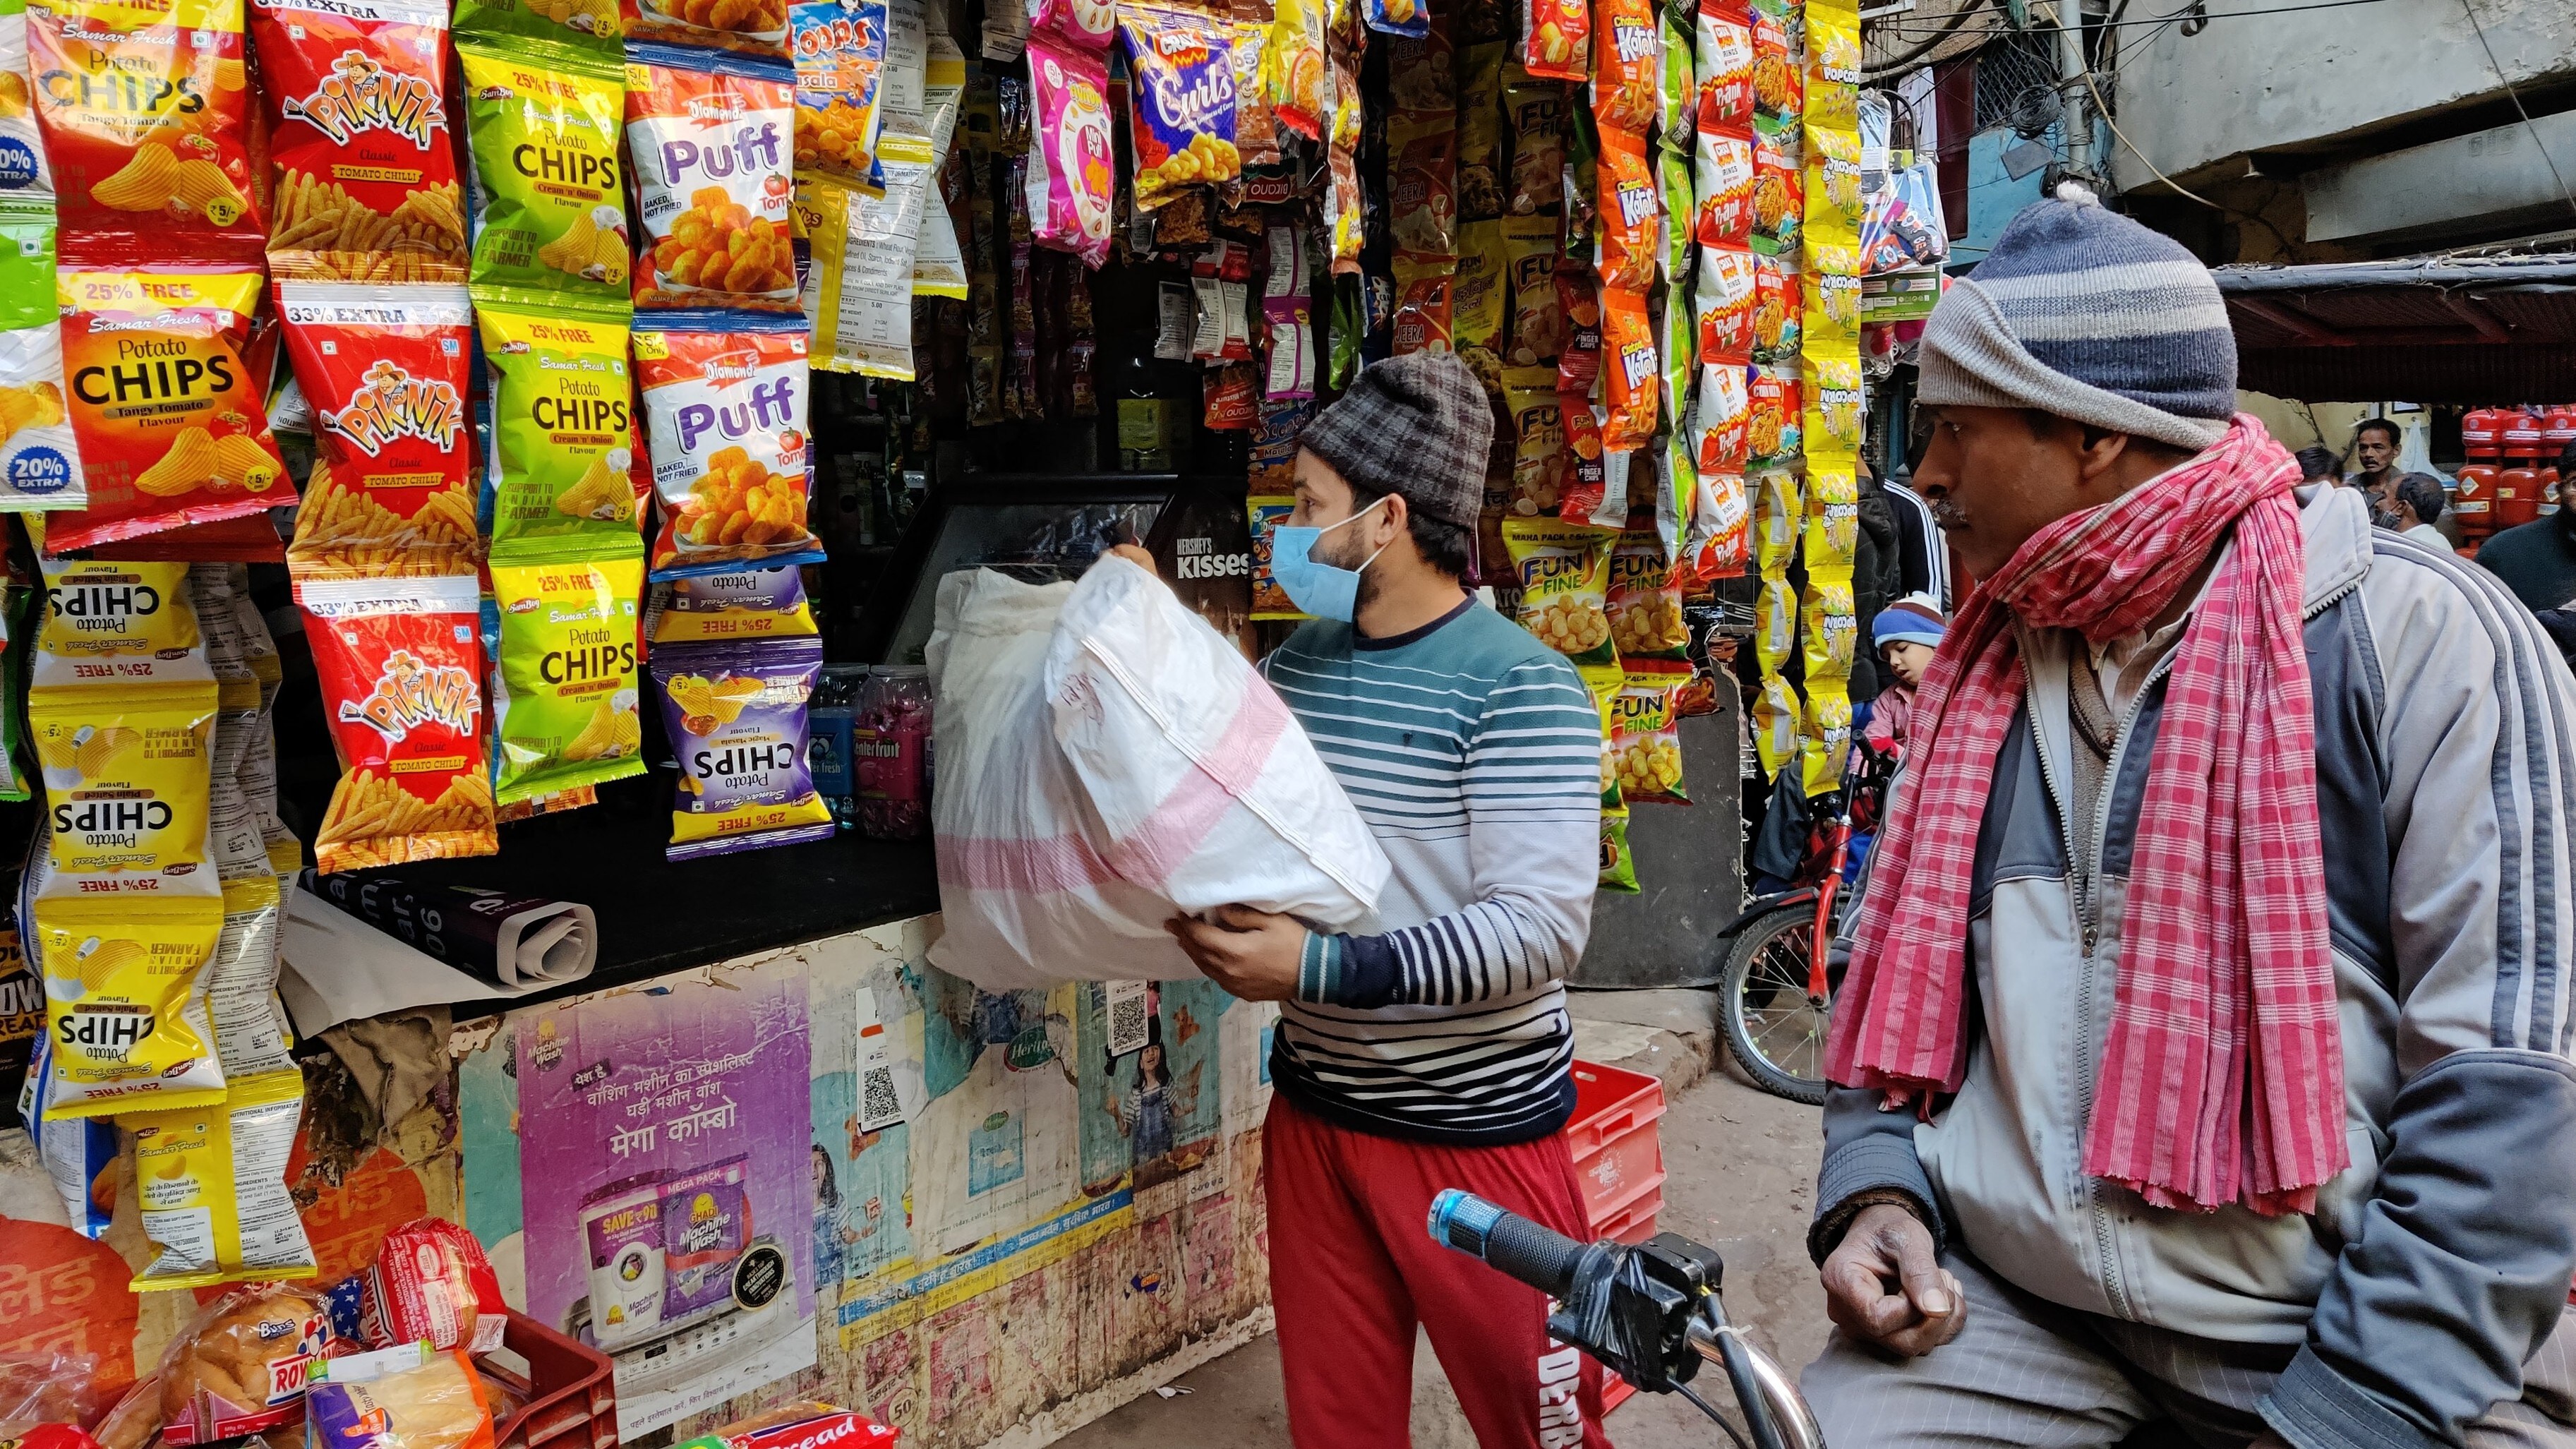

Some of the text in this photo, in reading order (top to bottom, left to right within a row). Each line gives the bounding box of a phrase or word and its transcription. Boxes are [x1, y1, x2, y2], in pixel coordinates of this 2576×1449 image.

[1395, 40, 1426, 61] JEERA
[1723, 49, 1739, 57] RINGS
[512, 71, 543, 95] 25%
[1823, 67, 1860, 85] POPCOR
[40, 70, 205, 114] CHIPS
[1155, 64, 1232, 128] Curls
[1223, 102, 1234, 112] Corn
[1085, 125, 1102, 144] Mini
[660, 121, 781, 188] Puff
[1088, 141, 1103, 160] Puff
[512, 143, 615, 189] CHIPS
[1722, 166, 1738, 176] RINGS
[339, 168, 419, 182] TOMATO CHILLI
[1396, 182, 1426, 202] JEERA
[660, 202, 682, 215] FRIED
[1821, 274, 1862, 290] OPCORN
[85, 282, 193, 300] 25% FREE
[88, 312, 202, 333] Samar Fresh
[289, 307, 406, 323] 33% EXTRA
[529, 324, 594, 343] 25% FREE
[1395, 325, 1424, 342] JEERA
[1575, 334, 1599, 343] FINGER
[118, 338, 187, 361] Potato
[442, 339, 458, 353] SM
[646, 346, 666, 356] Only
[540, 356, 606, 372] Samar Fresh
[73, 355, 234, 404] CHIPS
[560, 377, 600, 396] Potato
[116, 401, 203, 417] Tangy Tomato
[533, 397, 627, 431] CHIPS
[674, 377, 795, 453] Puff
[554, 435, 612, 444] Cream Onion
[569, 446, 596, 455] Flavour
[15, 457, 64, 478] 20%
[389, 457, 422, 467] Classic
[657, 461, 685, 475] BAKED,
[658, 467, 698, 484] NOT FRIED
[1578, 466, 1602, 476] FINGER
[18, 477, 63, 488] EXTRA
[369, 475, 439, 486] TOMATO CHILLI
[507, 483, 553, 493] SUPPORT TO
[503, 494, 552, 505] INDIAN
[502, 507, 548, 519] FARMER
[1512, 533, 1565, 542] MAHA PACK
[1625, 532, 1649, 541] PACK
[1176, 537, 1212, 555] HERSHEY'S
[1522, 552, 1584, 587] FUN
[1608, 552, 1667, 585] FUN
[538, 575, 569, 591] 25%
[713, 576, 756, 590] Potato
[1543, 572, 1584, 596] FINE
[1626, 572, 1666, 594] FINE
[50, 587, 160, 617] CHIPS
[311, 601, 352, 615] 33%
[508, 598, 540, 614] SamBoy
[732, 595, 774, 606] Samar
[549, 609, 588, 623] Samar
[77, 618, 126, 634] Potato
[702, 619, 772, 633] 25% FREE
[570, 628, 610, 647] Potato
[73, 663, 153, 678] 25% FREE
[540, 643, 634, 685] CHIPS
[561, 680, 618, 696] Cream Onion
[575, 694, 603, 704] Flavour
[1611, 695, 1664, 719] FUN
[1623, 714, 1663, 735] FINE
[159, 748, 196, 759] SUPPORT
[875, 741, 901, 758] fruit
[395, 759, 462, 771] TOMATO CHILLI
[694, 743, 795, 778] CHIPS
[726, 774, 769, 788] Potato
[714, 789, 786, 810] Samar Fresh
[55, 800, 173, 833] CHIPS
[718, 812, 786, 830] 25% FREE
[86, 834, 136, 848] Potato
[72, 853, 157, 868] Samar Fresh
[163, 862, 197, 875] SamBoy
[78, 879, 158, 892] 25% FREE
[150, 944, 200, 954] FARMER
[86, 1047, 128, 1062] Potato
[528, 1036, 569, 1059] Machine
[536, 1048, 562, 1064] Wash
[76, 1061, 152, 1078] Samar Fresh
[161, 1059, 195, 1078] SamBoy
[233, 1063, 258, 1072] PRODUCT
[575, 1071, 592, 1086] पेश
[587, 1052, 754, 1107] वॉशिंग मशीन का स्पेशलिस्ट
[84, 1082, 162, 1099] 25% FREE
[627, 1081, 721, 1118] घड़ी मशीन वॉश
[610, 1095, 737, 1158] मेगा कॉम्बो
[138, 1138, 205, 1158] Samar Fresh
[668, 1170, 721, 1194] MEGA PACK
[603, 1210, 634, 1234] SAVE
[690, 1206, 718, 1224] GHADI
[680, 1212, 730, 1246] Machine
[690, 1228, 721, 1253] Wash
[286, 1255, 300, 1263] INDIA
[628, 1291, 658, 1311] Machine
[635, 1302, 653, 1316] Wash
[606, 1313, 624, 1325] GHADI
[260, 1318, 295, 1338] Buns
[630, 1417, 645, 1429] पहले
[648, 1407, 672, 1424] इस्तेमाल
[689, 1394, 701, 1407] फिर
[725, 1380, 735, 1392] करें
[1538, 1347, 1584, 1449] DERB
[895, 1399, 912, 1419] 50
